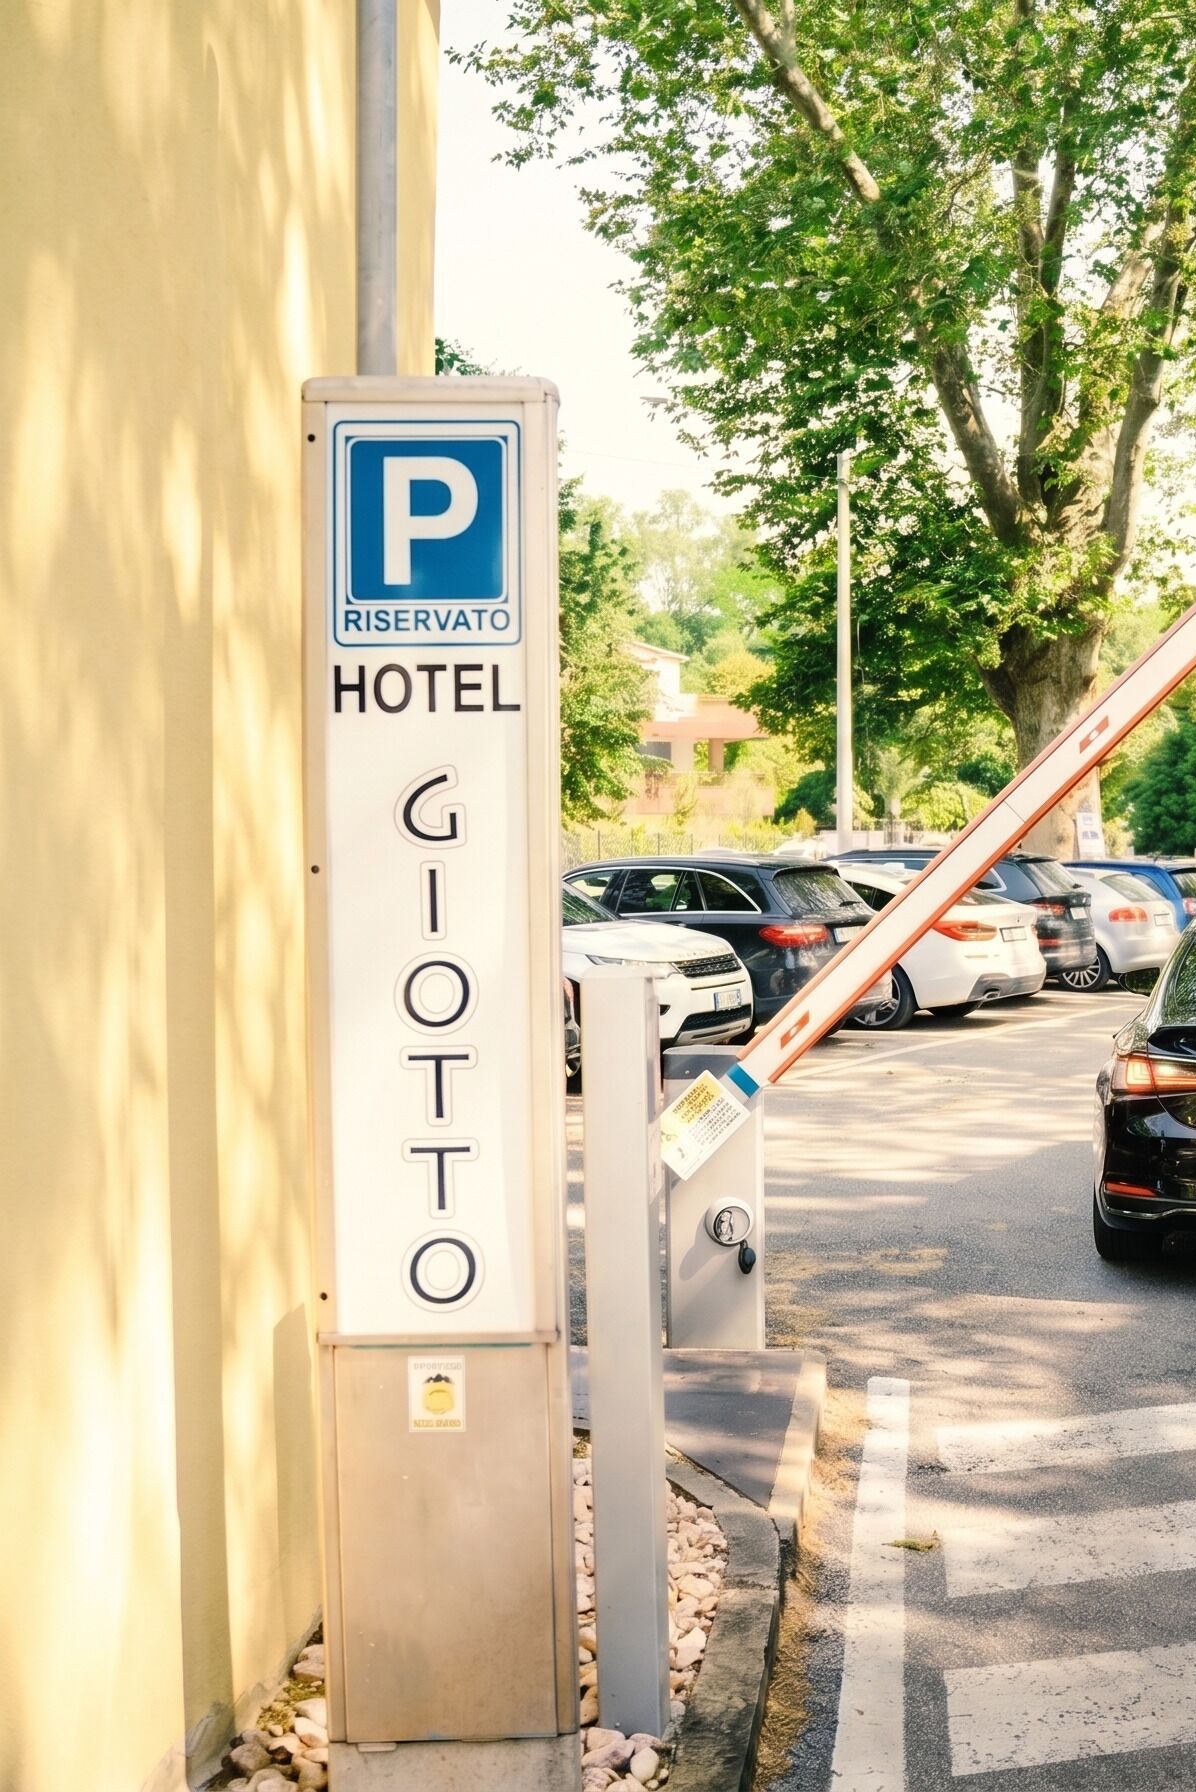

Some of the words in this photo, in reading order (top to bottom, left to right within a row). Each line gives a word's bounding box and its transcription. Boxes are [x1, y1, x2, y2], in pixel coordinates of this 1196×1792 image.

[383, 456, 479, 586] P
[344, 609, 511, 632] RISERVATO
[334, 663, 522, 714] HOTEL
[402, 773, 478, 1305] GIOTTO
